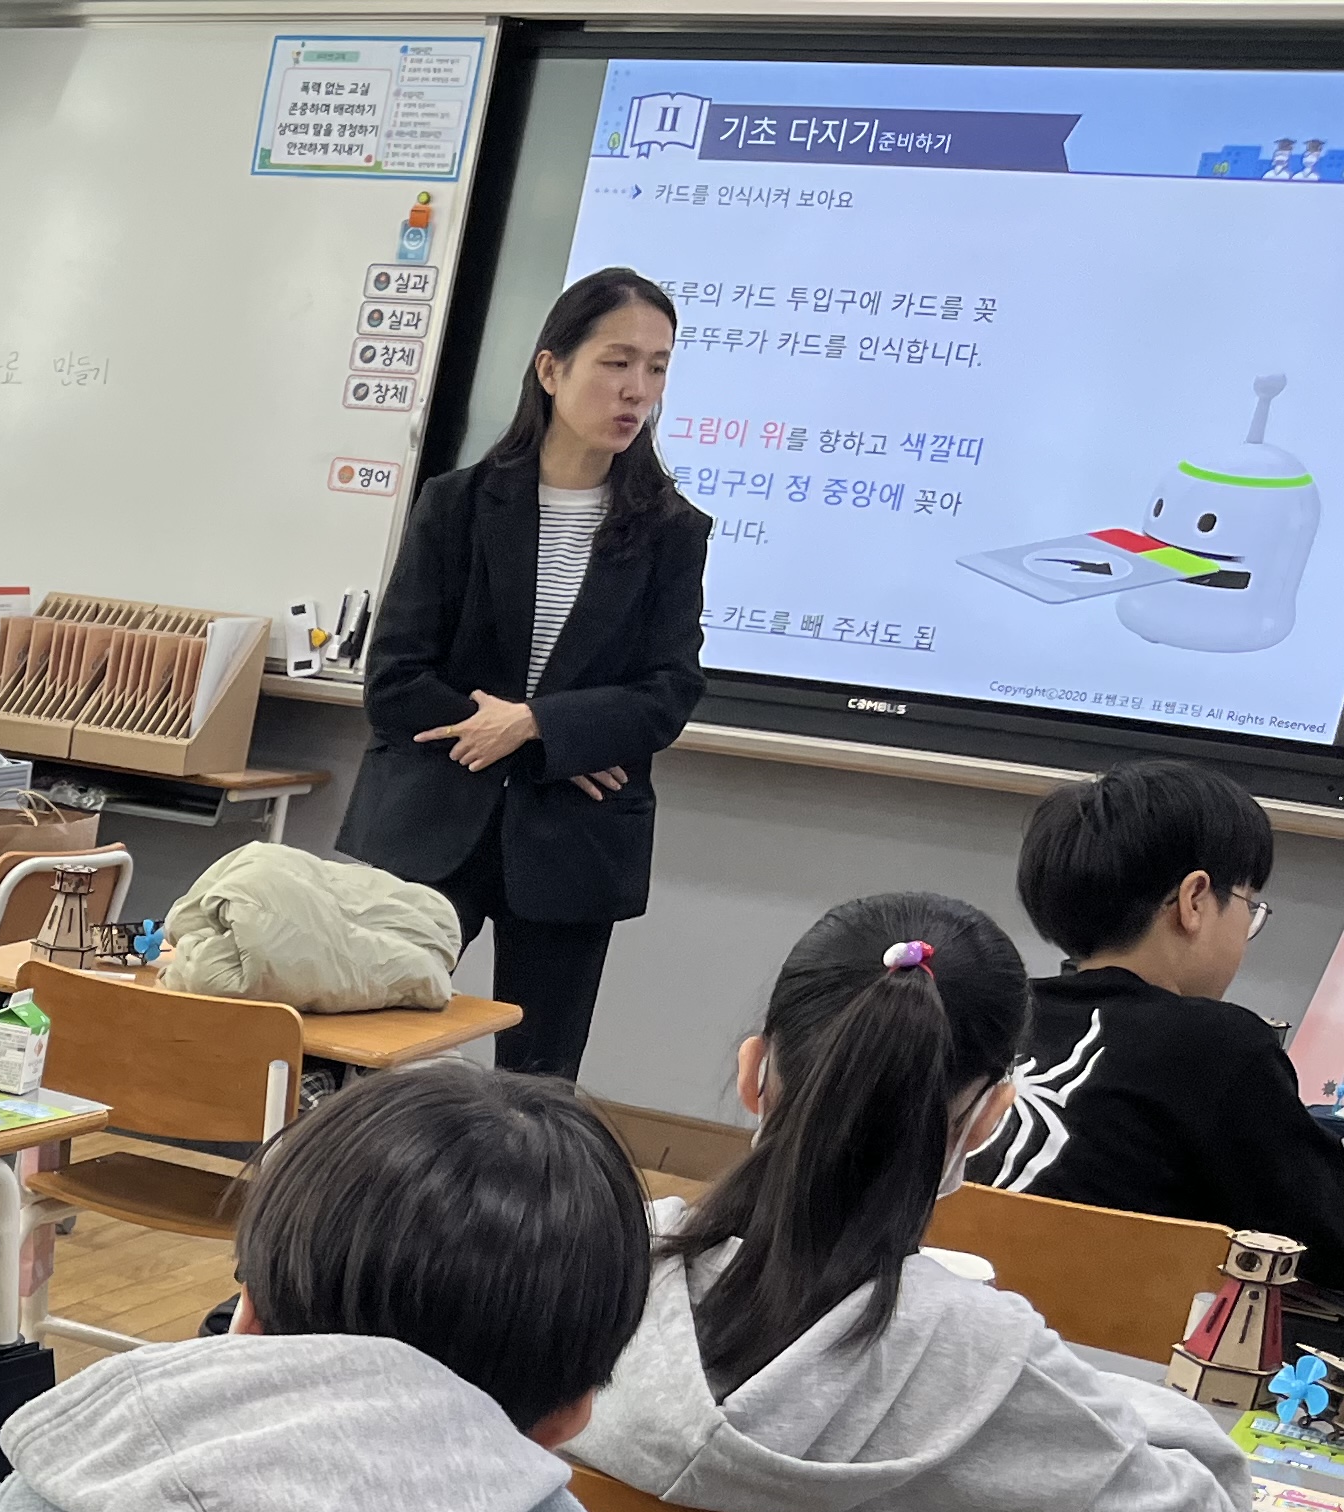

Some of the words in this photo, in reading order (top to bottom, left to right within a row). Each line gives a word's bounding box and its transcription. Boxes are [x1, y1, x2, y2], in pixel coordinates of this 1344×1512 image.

[300, 81, 321, 95] 폭력
[325, 82, 345, 95] 없는
[348, 82, 370, 96] 교실
[288, 102, 330, 116] 존중하며
[333, 103, 376, 117] 배려하기
[278, 123, 309, 137] 상대의
[312, 124, 333, 137] 말을
[337, 124, 378, 138] 경청하기
[719, 116, 776, 149] 기초
[287, 142, 329, 155] 안전하게
[333, 143, 364, 156] 지내기
[654, 184, 710, 206] 카드를
[717, 186, 791, 209] 인식시켜
[796, 190, 854, 209] 보아요
[395, 272, 429, 294] 실과
[732, 284, 776, 309] 카드
[786, 286, 882, 316] 투입구에
[891, 292, 964, 322] 카드를
[973, 297, 998, 323] 꽂
[388, 309, 422, 331] 실과
[381, 346, 415, 367] 창체
[777, 331, 847, 359] 카드를
[858, 335, 982, 368] 인식합니다.
[53, 350, 110, 386] 만들기
[373, 383, 408, 404] 창체
[668, 416, 750, 448] 그림이
[760, 421, 808, 452] 위를
[819, 428, 888, 457] 향하고
[900, 432, 984, 466] 색깔띠
[358, 467, 391, 489] 영어
[672, 465, 774, 500] 투입구의
[785, 474, 811, 502] 정
[822, 477, 905, 511] 중앙에
[913, 489, 962, 517] 꽂아
[723, 606, 790, 635] 카드를
[802, 615, 822, 639] 빼
[833, 617, 902, 646] 주셔도
[916, 626, 936, 651] 됩
[1206, 708, 1223, 720] All
[1227, 710, 1265, 726] Rights
[1269, 716, 1327, 734] Reserved.
